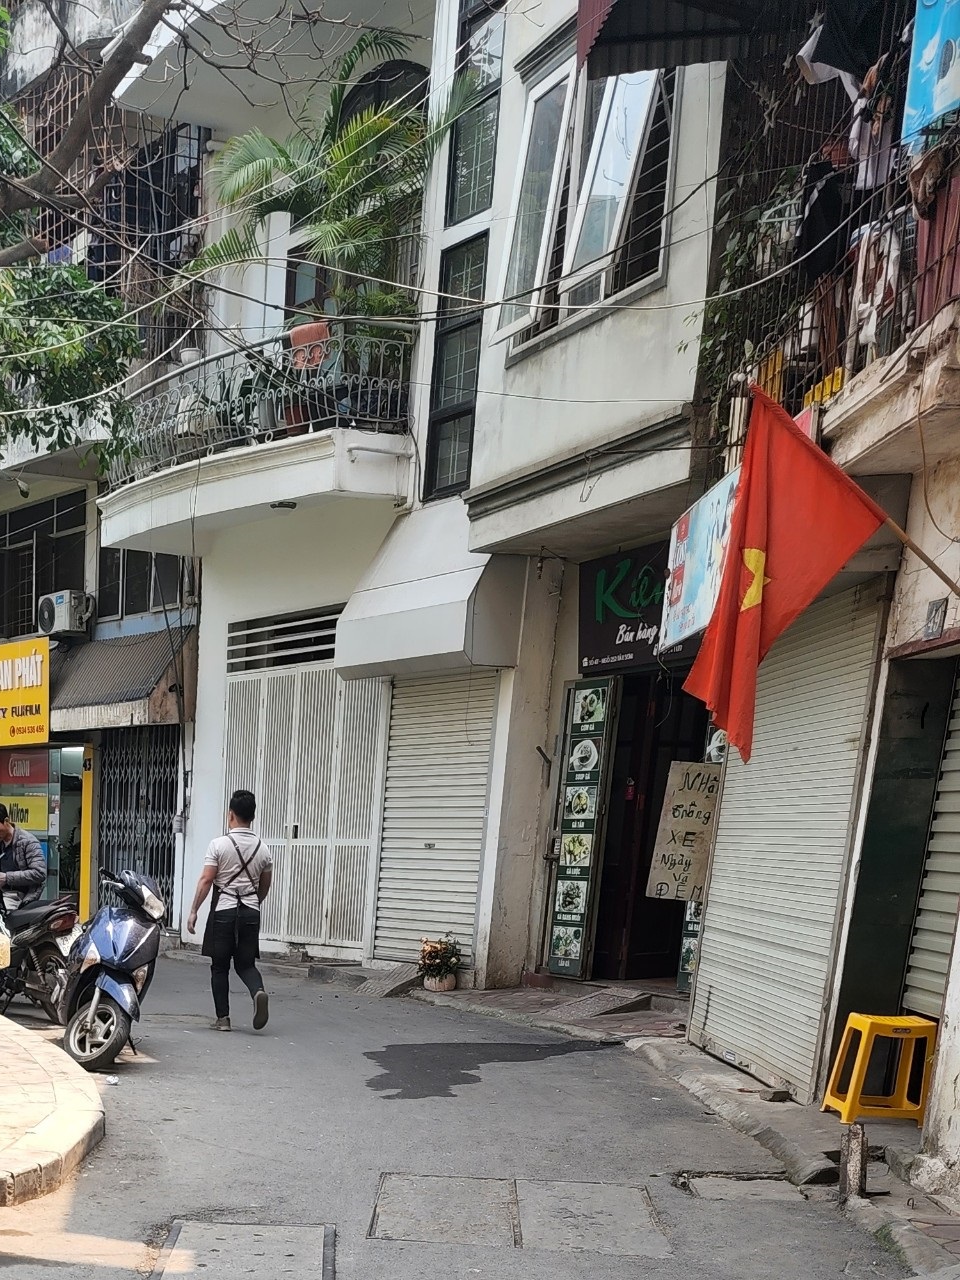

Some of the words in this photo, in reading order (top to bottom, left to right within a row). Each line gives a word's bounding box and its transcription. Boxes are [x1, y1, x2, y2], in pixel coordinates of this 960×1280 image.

[615, 623, 636, 645] Bán
[636, 622, 658, 645] hàng
[14, 648, 44, 689] PHÁT
[11, 703, 42, 718] FUJIFILM
[8, 757, 30, 778] Canon
[8, 803, 30, 824] Nikon
[666, 830, 696, 847] XE
